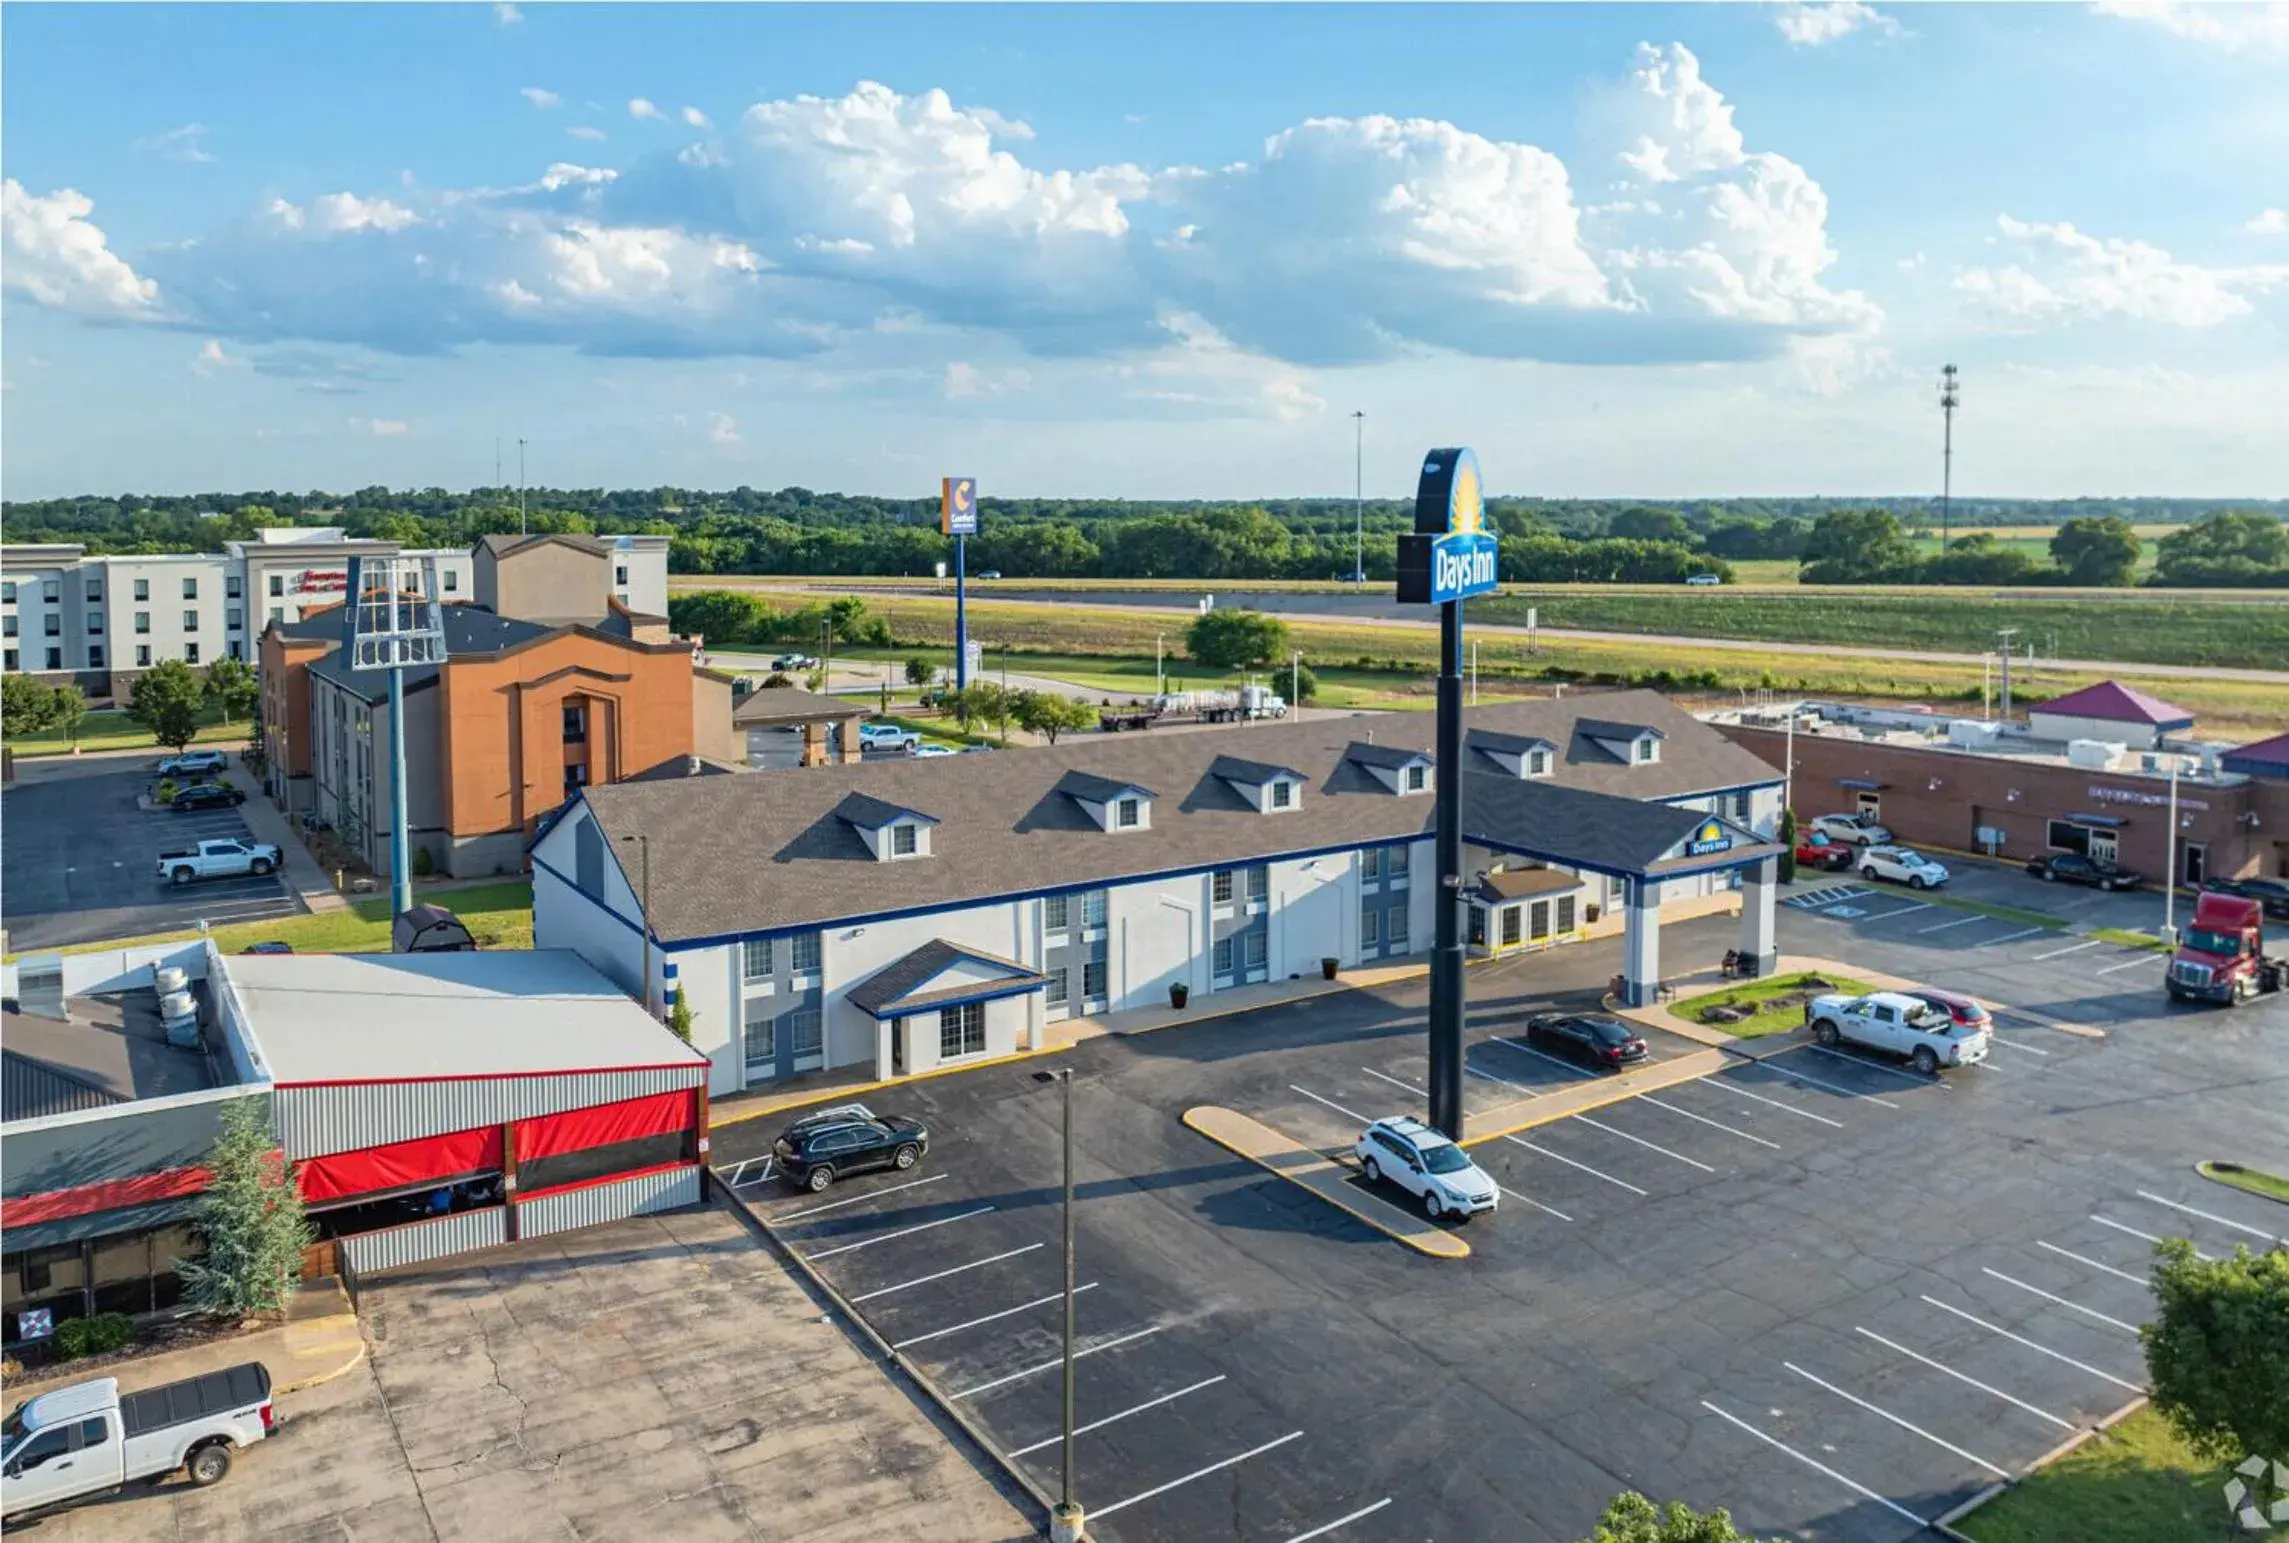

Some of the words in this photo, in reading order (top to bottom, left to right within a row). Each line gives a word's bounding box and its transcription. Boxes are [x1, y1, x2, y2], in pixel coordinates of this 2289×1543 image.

[1436, 548, 1472, 593] Days
[1473, 545, 1494, 584] Inn
[1693, 842, 1714, 854] Days
